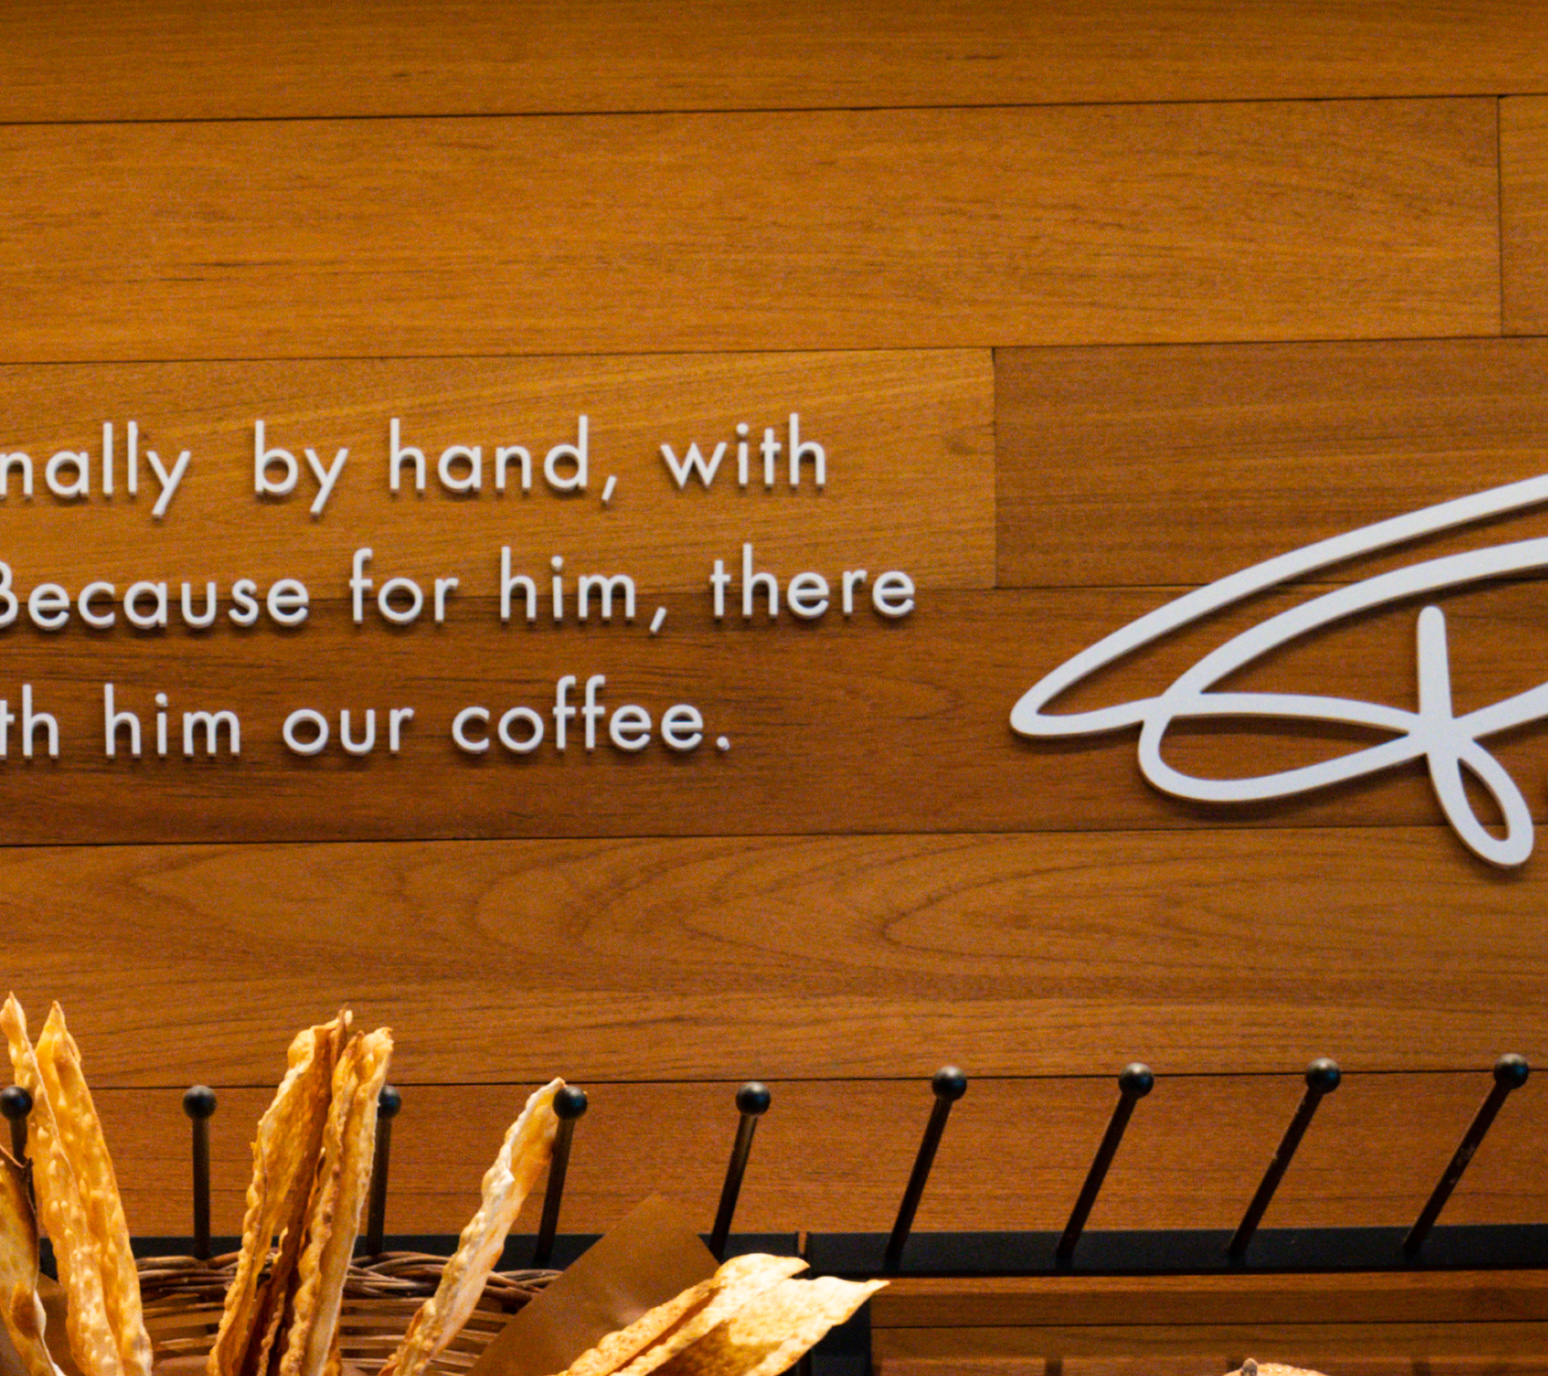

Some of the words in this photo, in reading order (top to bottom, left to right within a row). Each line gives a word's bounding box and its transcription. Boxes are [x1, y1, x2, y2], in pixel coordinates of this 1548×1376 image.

[252, 416, 351, 516] by
[387, 411, 620, 503] hand,
[657, 409, 829, 490] with
[347, 544, 462, 624] for
[498, 542, 669, 635] him,
[707, 540, 918, 619] there
[102, 680, 243, 758] him
[280, 705, 417, 756] our
[450, 671, 733, 754] coffee.
